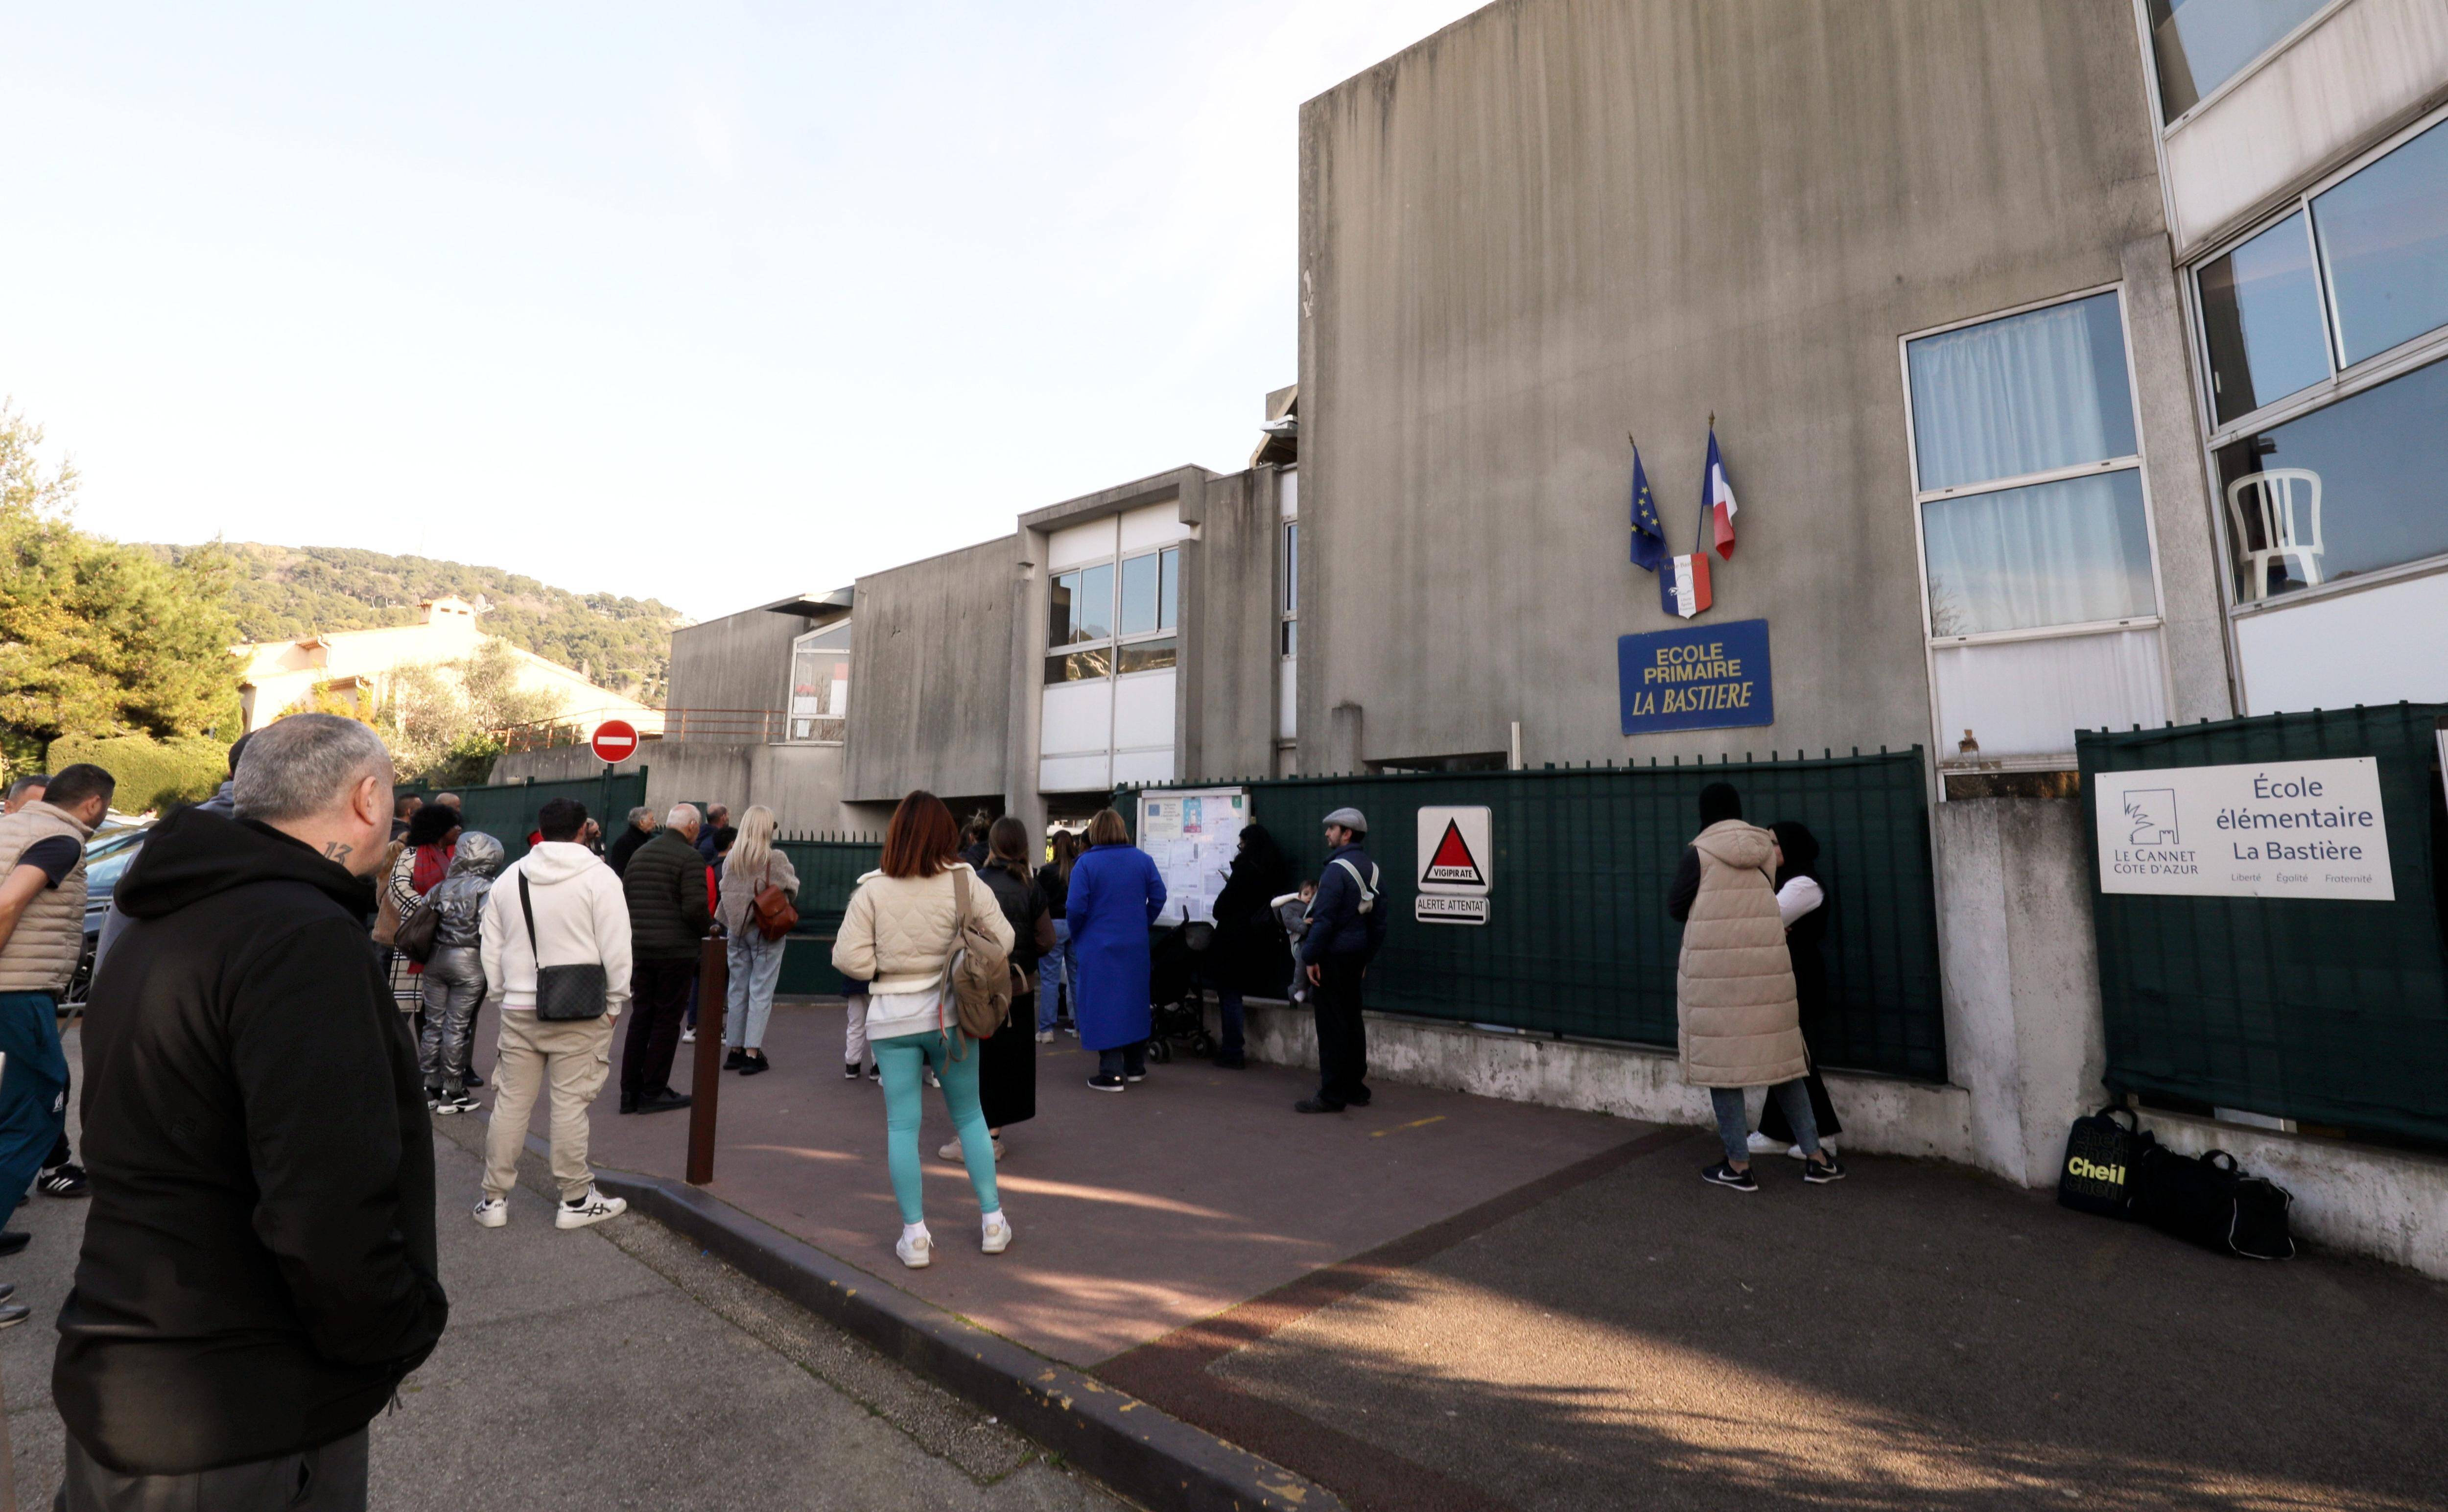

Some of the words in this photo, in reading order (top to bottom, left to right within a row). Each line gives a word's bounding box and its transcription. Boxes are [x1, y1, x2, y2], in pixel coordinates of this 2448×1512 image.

[1656, 642, 1724, 665] ECOLE
[1644, 659, 1742, 685] PRIMAIRE
[1632, 691, 1655, 716] LA
[1662, 681, 1754, 713] BASTIERE
[2254, 773, 2323, 799] École
[2216, 805, 2373, 829] élémentaire
[2115, 850, 2130, 862] LE
[2135, 849, 2195, 862] CANNET
[2233, 842, 2259, 859] La
[2266, 840, 2362, 860] Bastière
[1434, 868, 1473, 878] VIGIPIRATE
[2151, 865, 2199, 874] D'AZUR
[2231, 873, 2261, 881] Liberté
[2277, 872, 2308, 883] Égalité
[2326, 874, 2372, 883] Fraternité
[1418, 898, 1444, 910] ALERTE
[1448, 899, 1483, 912] ATTENTAT
[2068, 1156, 2126, 1185] Cheil
